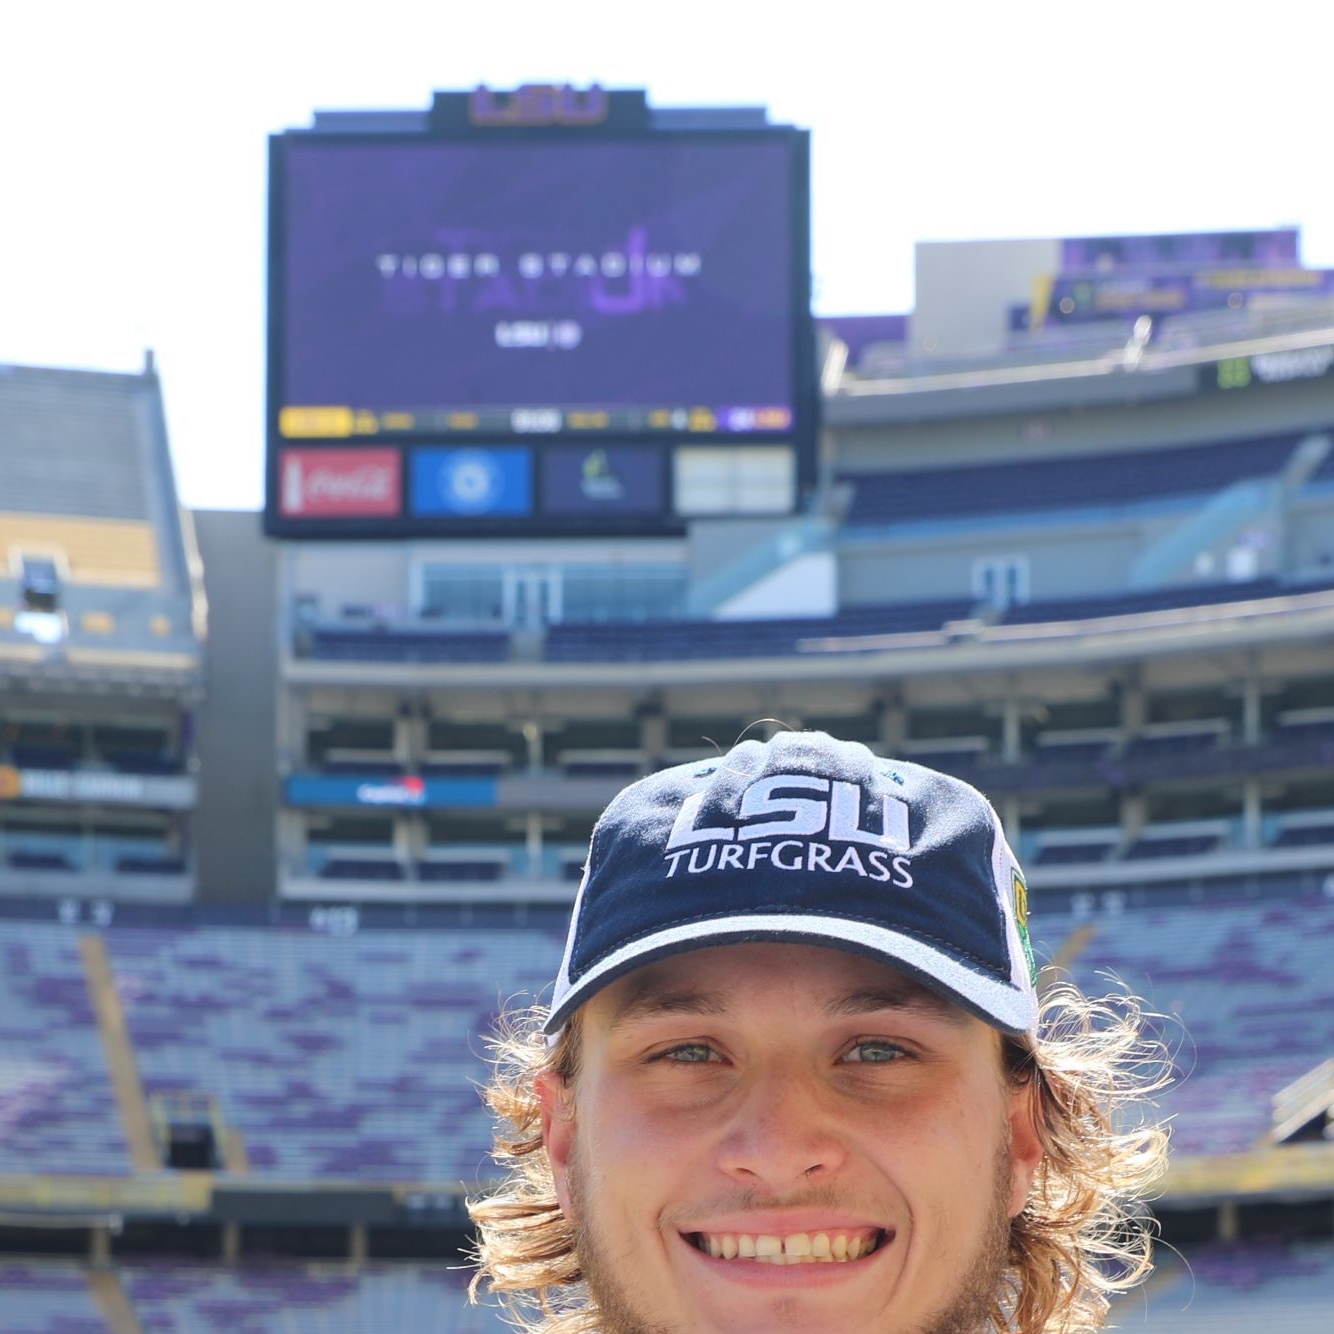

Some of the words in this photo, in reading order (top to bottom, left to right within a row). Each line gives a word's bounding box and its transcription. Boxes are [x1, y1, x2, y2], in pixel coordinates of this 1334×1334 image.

[376, 252, 500, 279] TIGER
[518, 252, 702, 279] STADIUM
[667, 774, 910, 851] LSU
[665, 839, 915, 890] TURFGRASS
